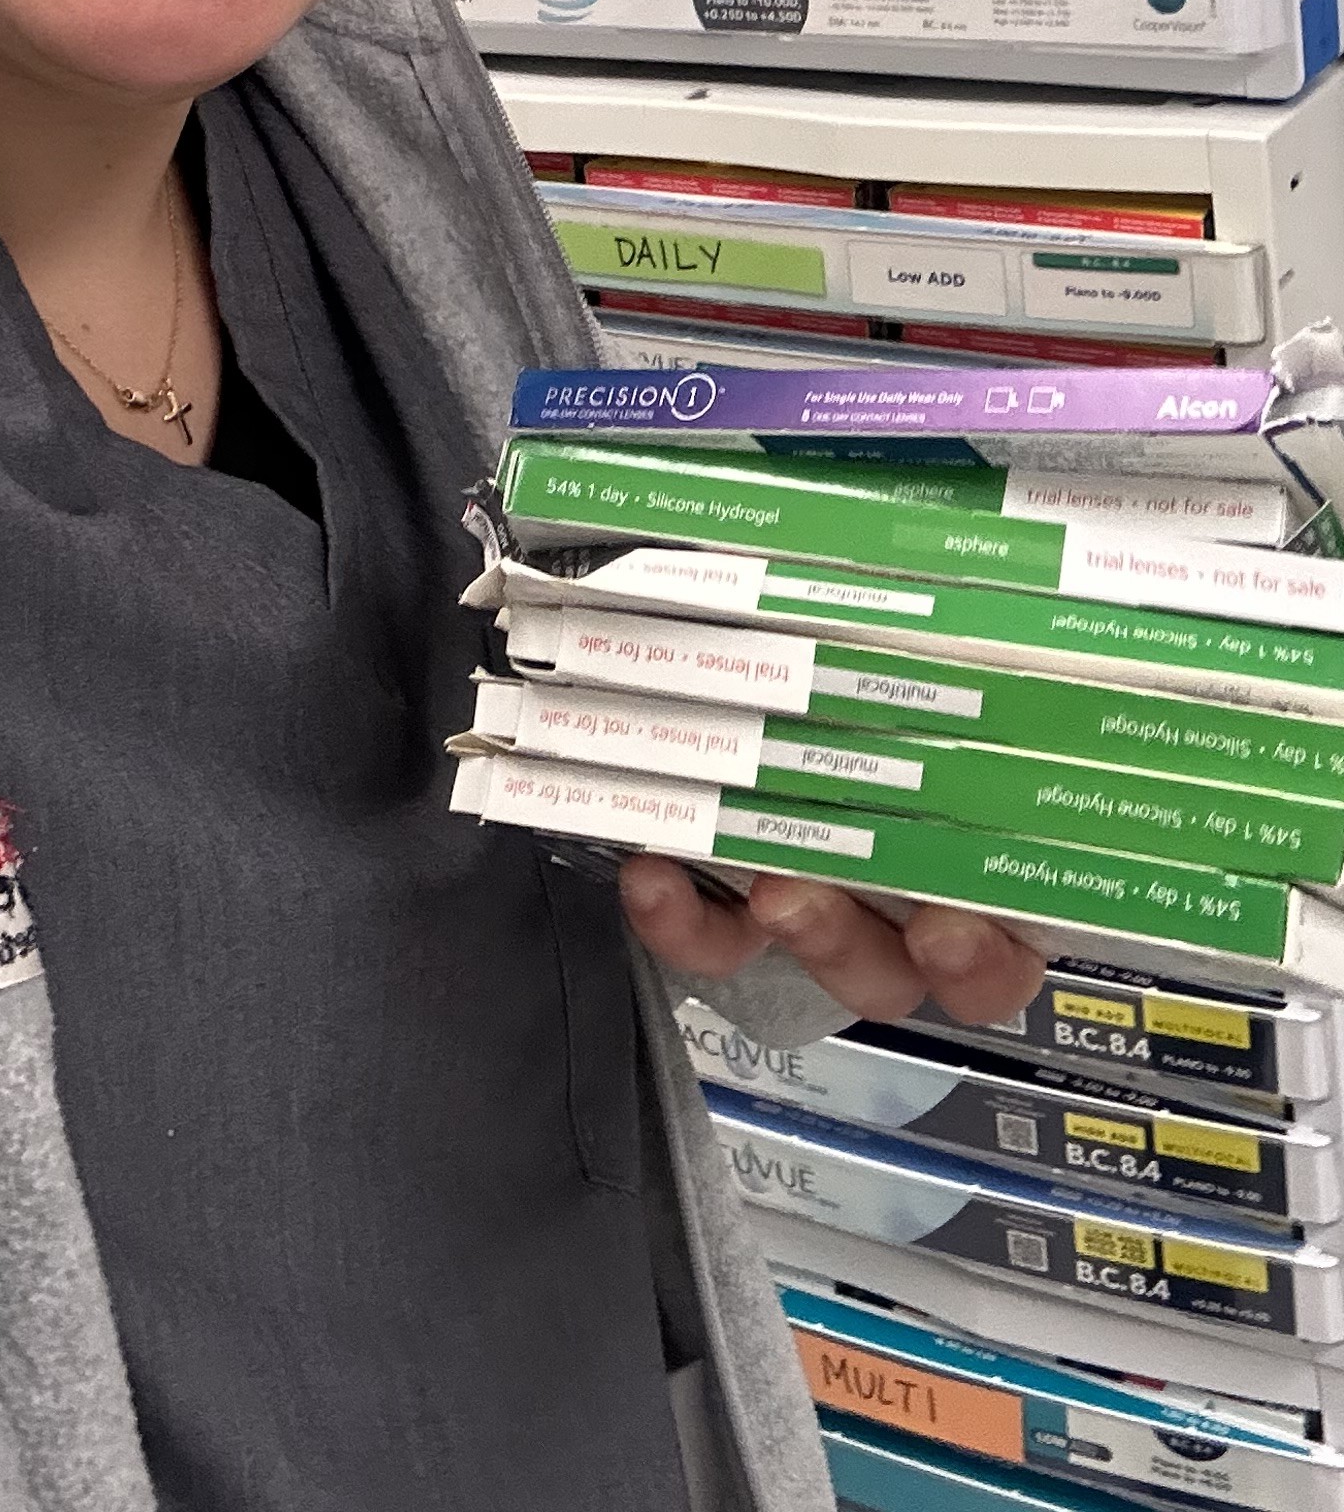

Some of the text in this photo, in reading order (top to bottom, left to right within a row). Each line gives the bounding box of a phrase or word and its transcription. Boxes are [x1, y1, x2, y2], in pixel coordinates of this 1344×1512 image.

[1132, 18, 1202, 32] CooperVision
[617, 235, 723, 276] DAILY
[887, 268, 966, 288] Low ADD
[1064, 286, 1098, 299] Plano
[804, 391, 963, 406] For Single Use Daily Wear Only
[1157, 393, 1238, 421] Alcon
[545, 477, 780, 527] 54% 1 day Silicone Hydrogel
[1027, 488, 1254, 519] trial lenses not for sale
[944, 535, 1009, 558] asphere
[1086, 549, 1325, 599] trial lenses not for sale
[1052, 613, 1314, 666] 54% 1 day Silicone Hydrogel
[578, 634, 790, 683] trial lenses not for sale
[857, 675, 937, 702] multifocal
[539, 708, 739, 756] trial lenses not for sale
[1100, 715, 1180, 746] Hydrogel
[1184, 728, 1250, 759] Silicone
[802, 747, 878, 774] multifocal
[1273, 741, 1307, 768] day
[1314, 752, 1322, 770] 1
[504, 775, 697, 824] trial lenses not for sale
[757, 815, 831, 843] multifocal
[1036, 786, 1302, 850] 54% 1 day Silicone Hydrogel
[984, 854, 1242, 921] 54% 1 day Silicone Hydrogel
[1152, 1019, 1242, 1045] MULTIFOCAL
[683, 1023, 805, 1081] ACUVUE
[821, 1354, 939, 1423] MULTI
